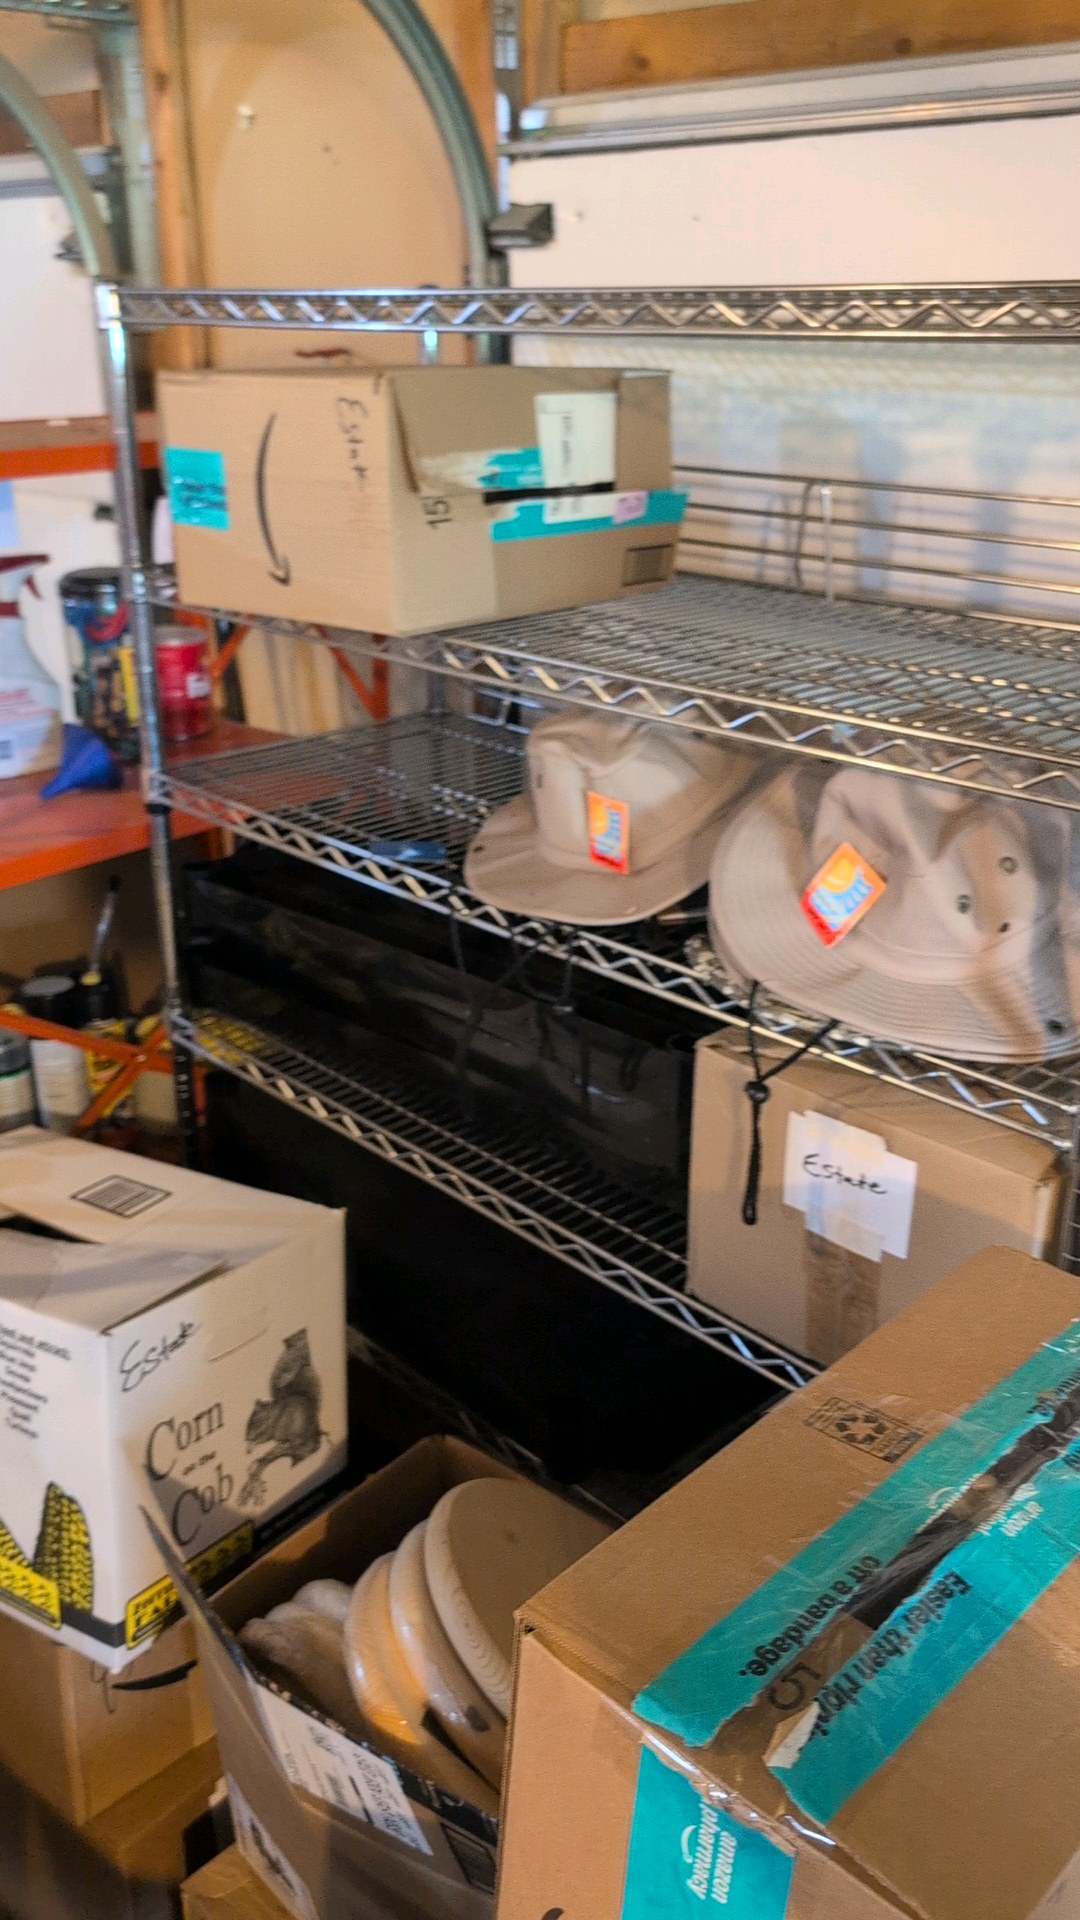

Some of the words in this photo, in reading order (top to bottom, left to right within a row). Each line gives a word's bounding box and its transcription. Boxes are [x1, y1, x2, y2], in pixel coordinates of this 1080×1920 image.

[803, 1153, 888, 1194] Estate
[146, 1402, 225, 1481] Corn
[172, 1463, 234, 1547] Cob
[902, 1570, 973, 1635] Easier
[854, 1627, 913, 1681] than
[809, 1673, 862, 1740] rippi
[686, 1803, 721, 1900] pharmacy
[711, 1830, 738, 1904] amazon
